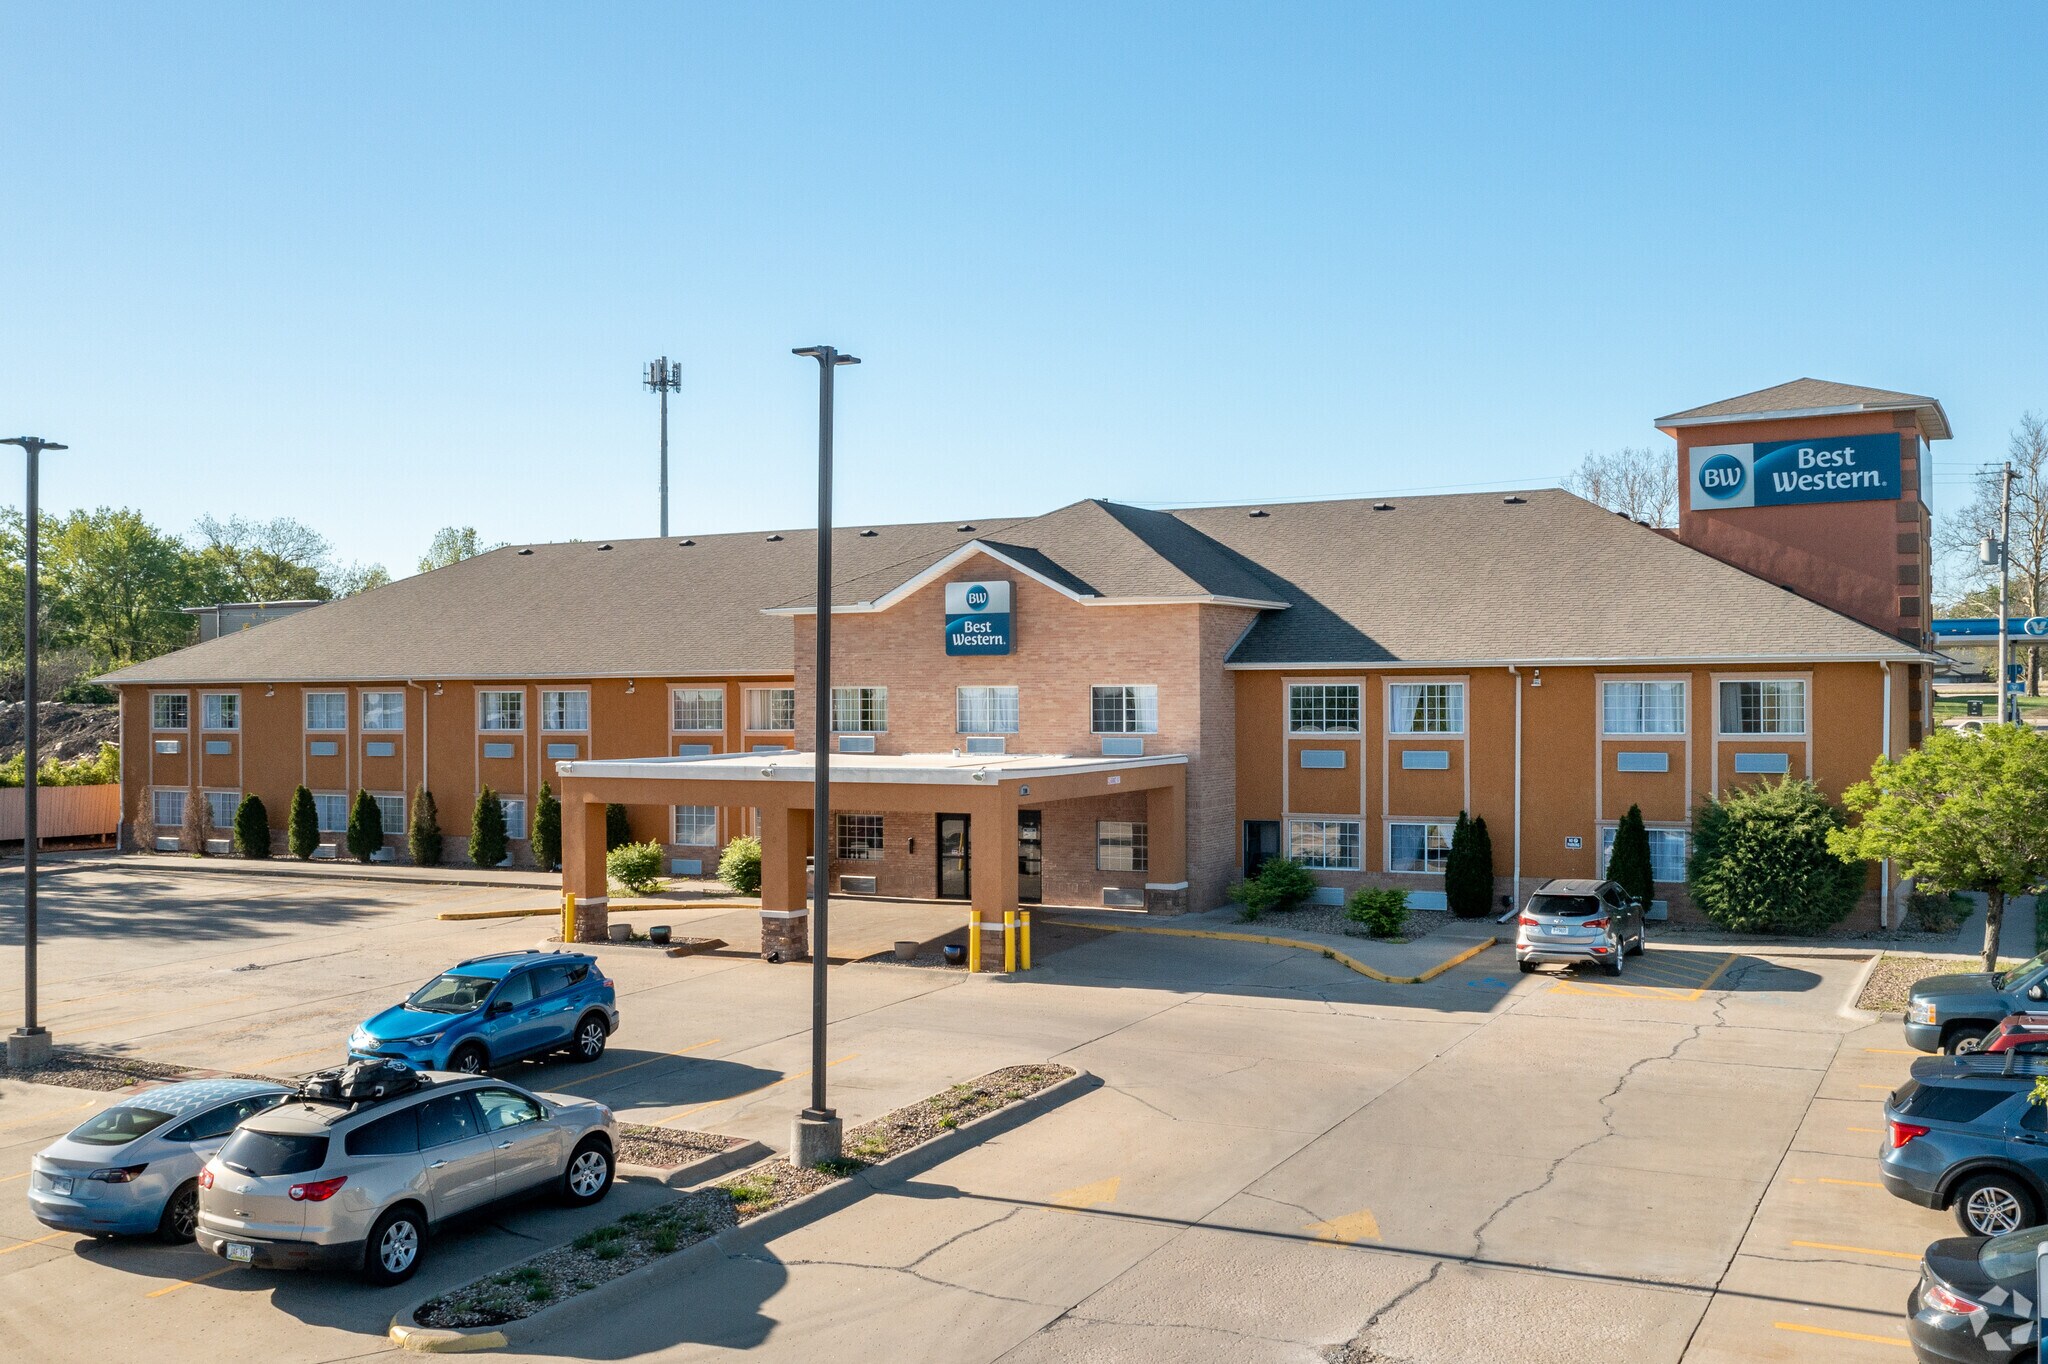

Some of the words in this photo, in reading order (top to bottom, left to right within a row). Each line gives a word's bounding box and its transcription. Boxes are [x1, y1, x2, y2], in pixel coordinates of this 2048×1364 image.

[1798, 446, 1856, 469] Best
[1704, 467, 1741, 488] BW
[1772, 470, 1882, 493] Western
[968, 592, 987, 604] BW
[964, 620, 992, 633] Best
[952, 633, 1004, 646] Western
